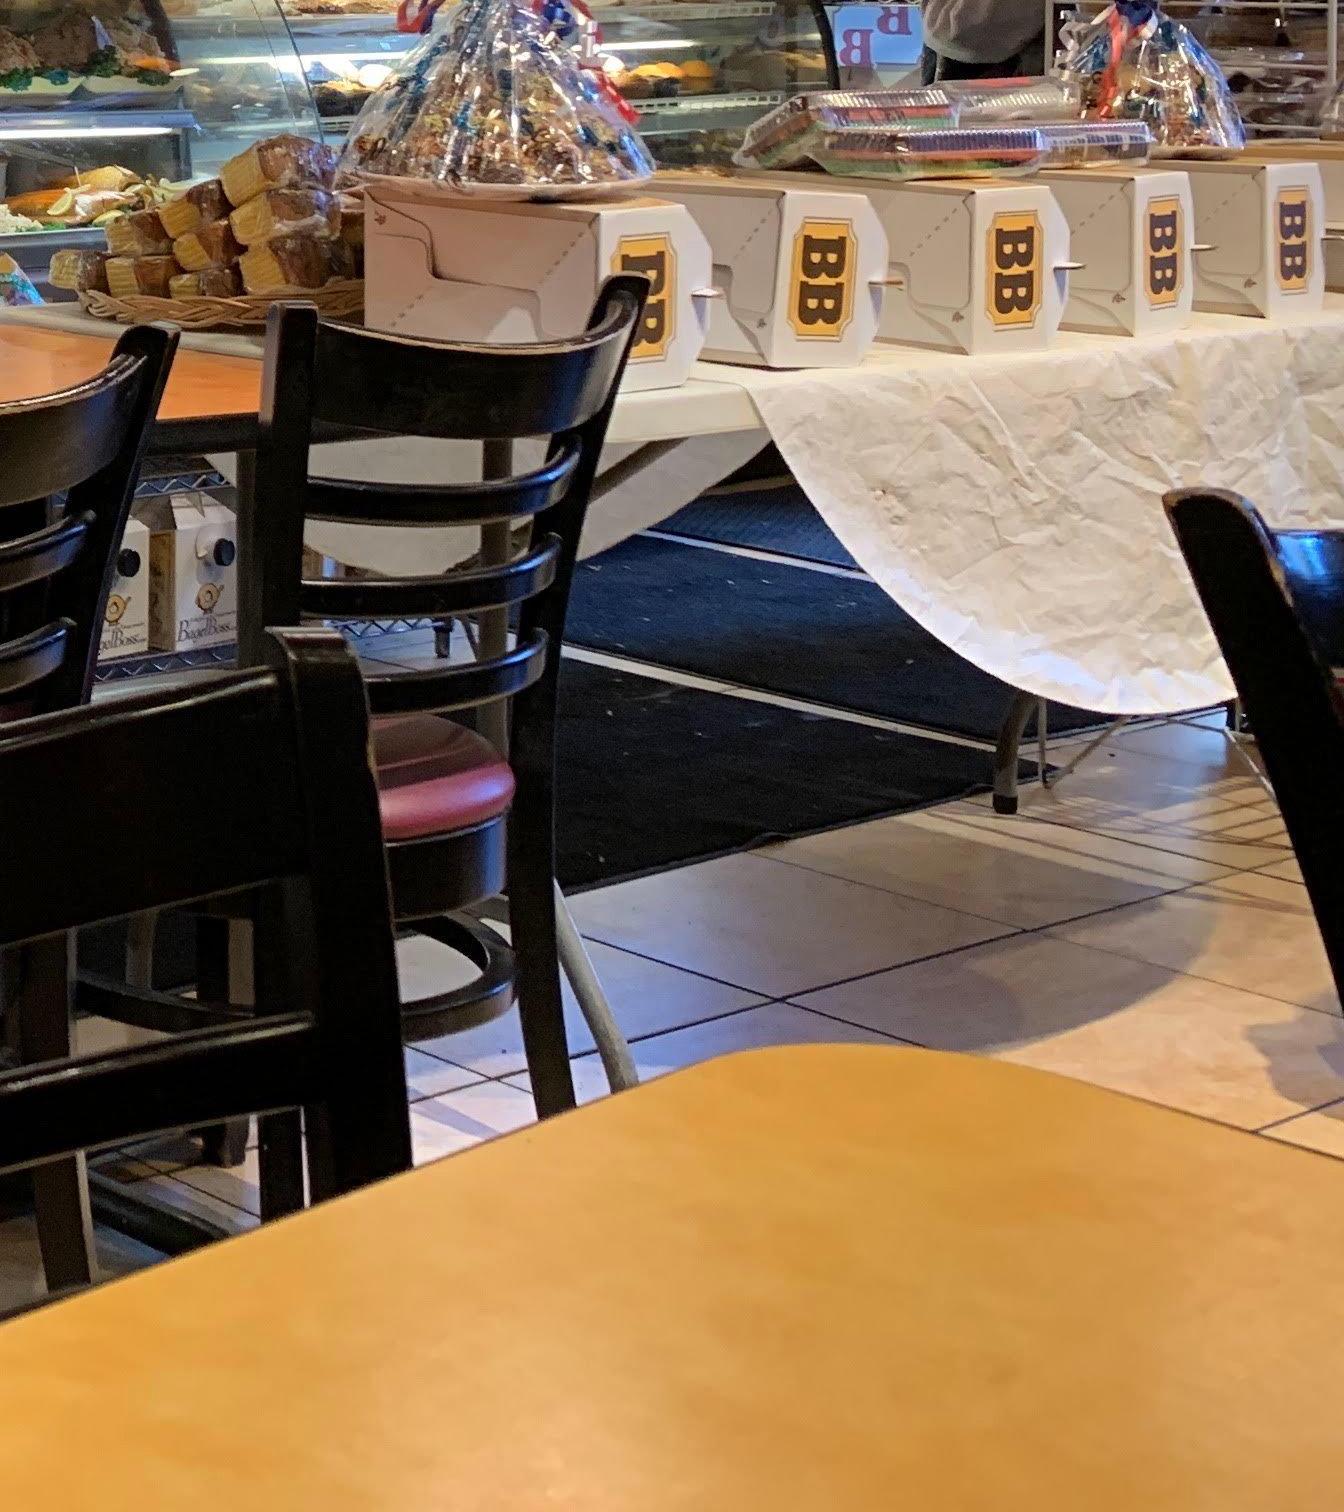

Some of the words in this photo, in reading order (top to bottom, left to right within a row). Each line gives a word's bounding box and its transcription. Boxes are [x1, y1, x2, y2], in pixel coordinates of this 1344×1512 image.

[795, 233, 849, 328] BB
[992, 224, 1037, 315] BB
[1146, 207, 1178, 298] BB
[1277, 199, 1309, 283] BB
